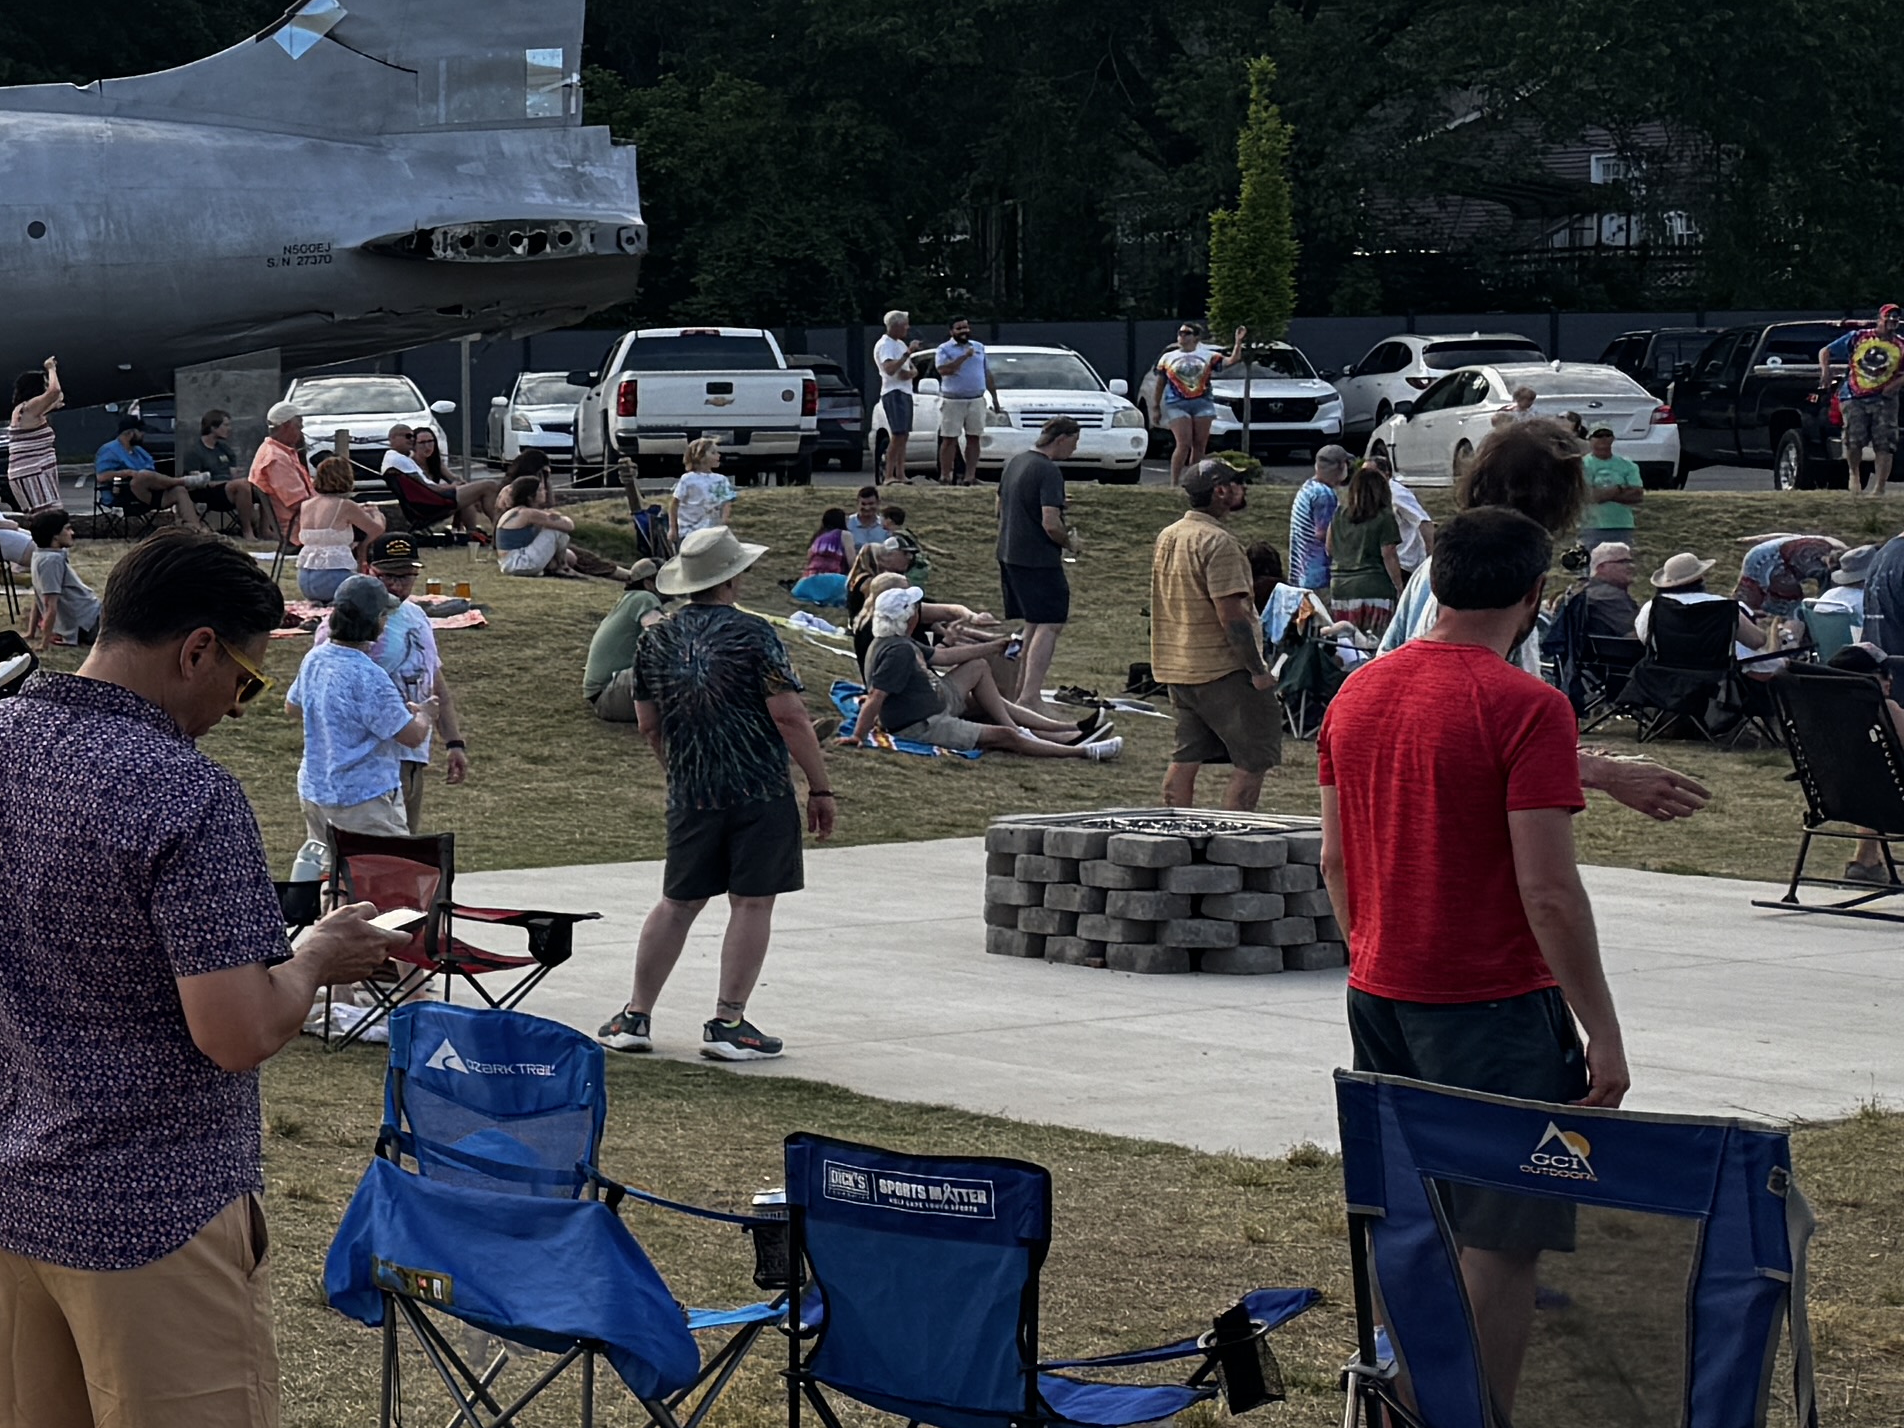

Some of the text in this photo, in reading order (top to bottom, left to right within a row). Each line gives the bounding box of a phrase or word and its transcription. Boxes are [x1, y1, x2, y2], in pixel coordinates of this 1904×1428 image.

[1530, 1152, 1579, 1169] GCI
[830, 1169, 867, 1190] DICK'S
[878, 1178, 927, 1200] SPORTS
[928, 1182, 988, 1205] MATTER
